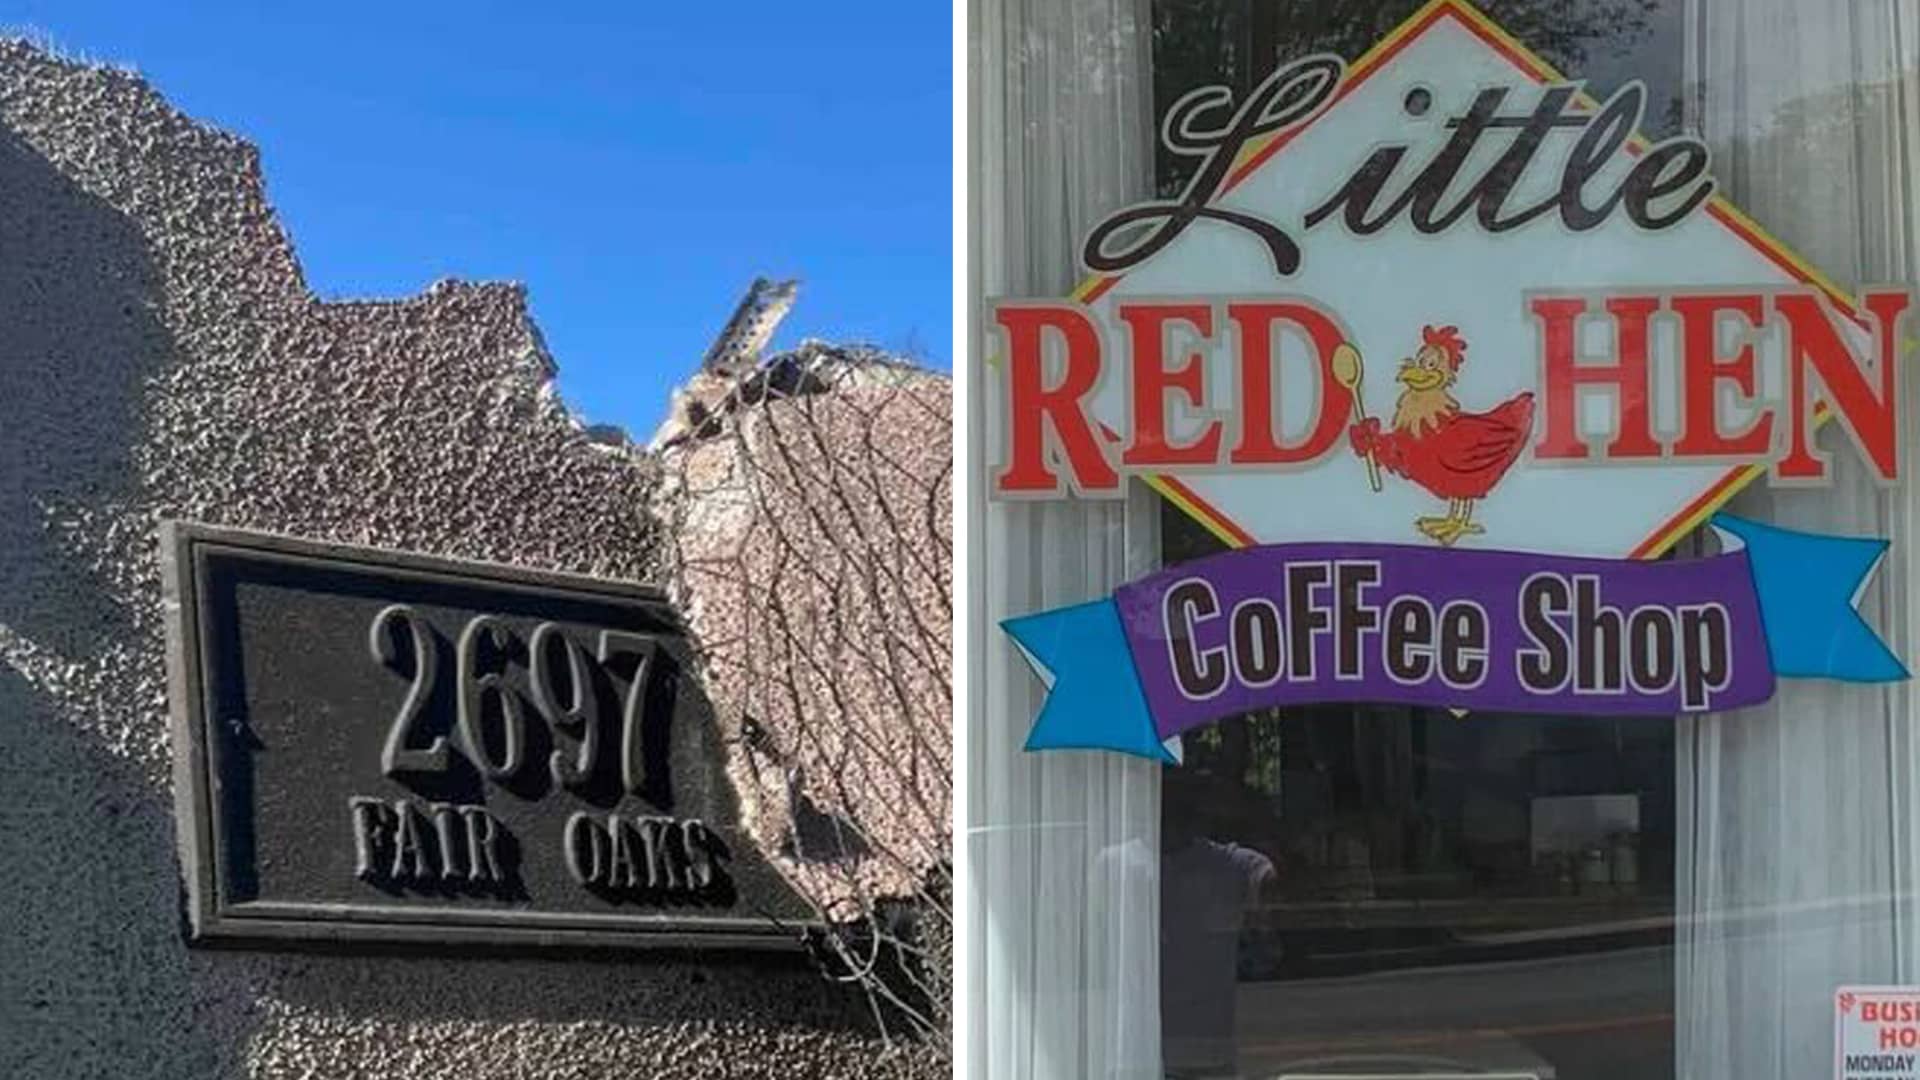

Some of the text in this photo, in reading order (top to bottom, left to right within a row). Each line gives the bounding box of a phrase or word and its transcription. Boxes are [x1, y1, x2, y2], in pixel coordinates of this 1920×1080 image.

[1083, 54, 1715, 276] Little
[994, 291, 1910, 491] RED HEN
[370, 604, 659, 790] 2697
[1515, 570, 1733, 712] Shop
[350, 798, 724, 890] FAIR OAKS
[1845, 1055, 1915, 1072] MONDAY
